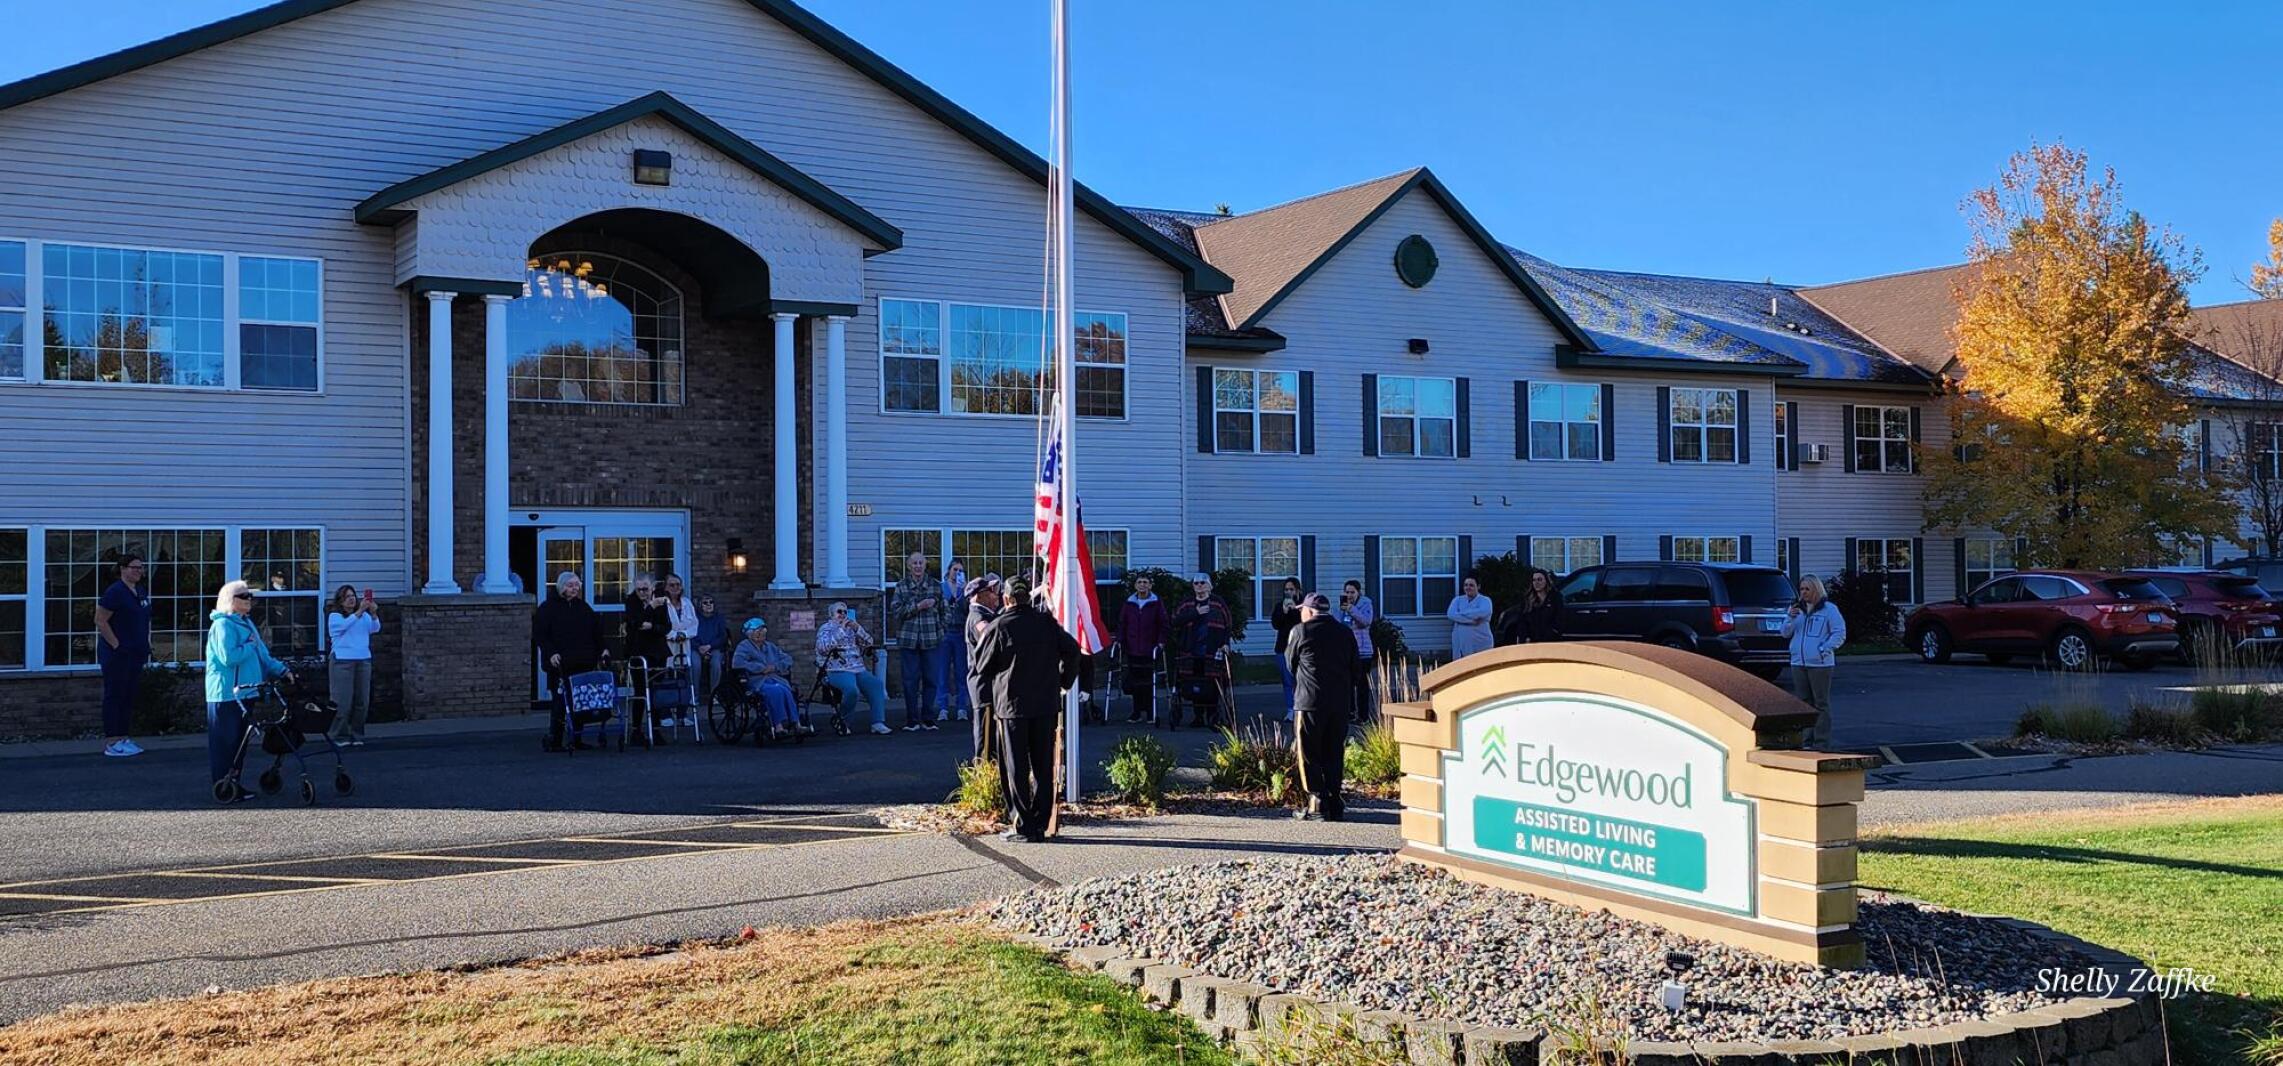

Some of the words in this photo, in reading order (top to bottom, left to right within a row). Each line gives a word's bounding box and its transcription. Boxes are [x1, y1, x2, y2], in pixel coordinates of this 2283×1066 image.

[1517, 742, 1692, 809] Edgewood
[1514, 807, 1591, 836] ASSISTED
[1595, 820, 1656, 849] LIVING
[1515, 832, 1526, 850] &
[1531, 834, 1606, 865] MEMORY
[1609, 850, 1656, 876] CARE
